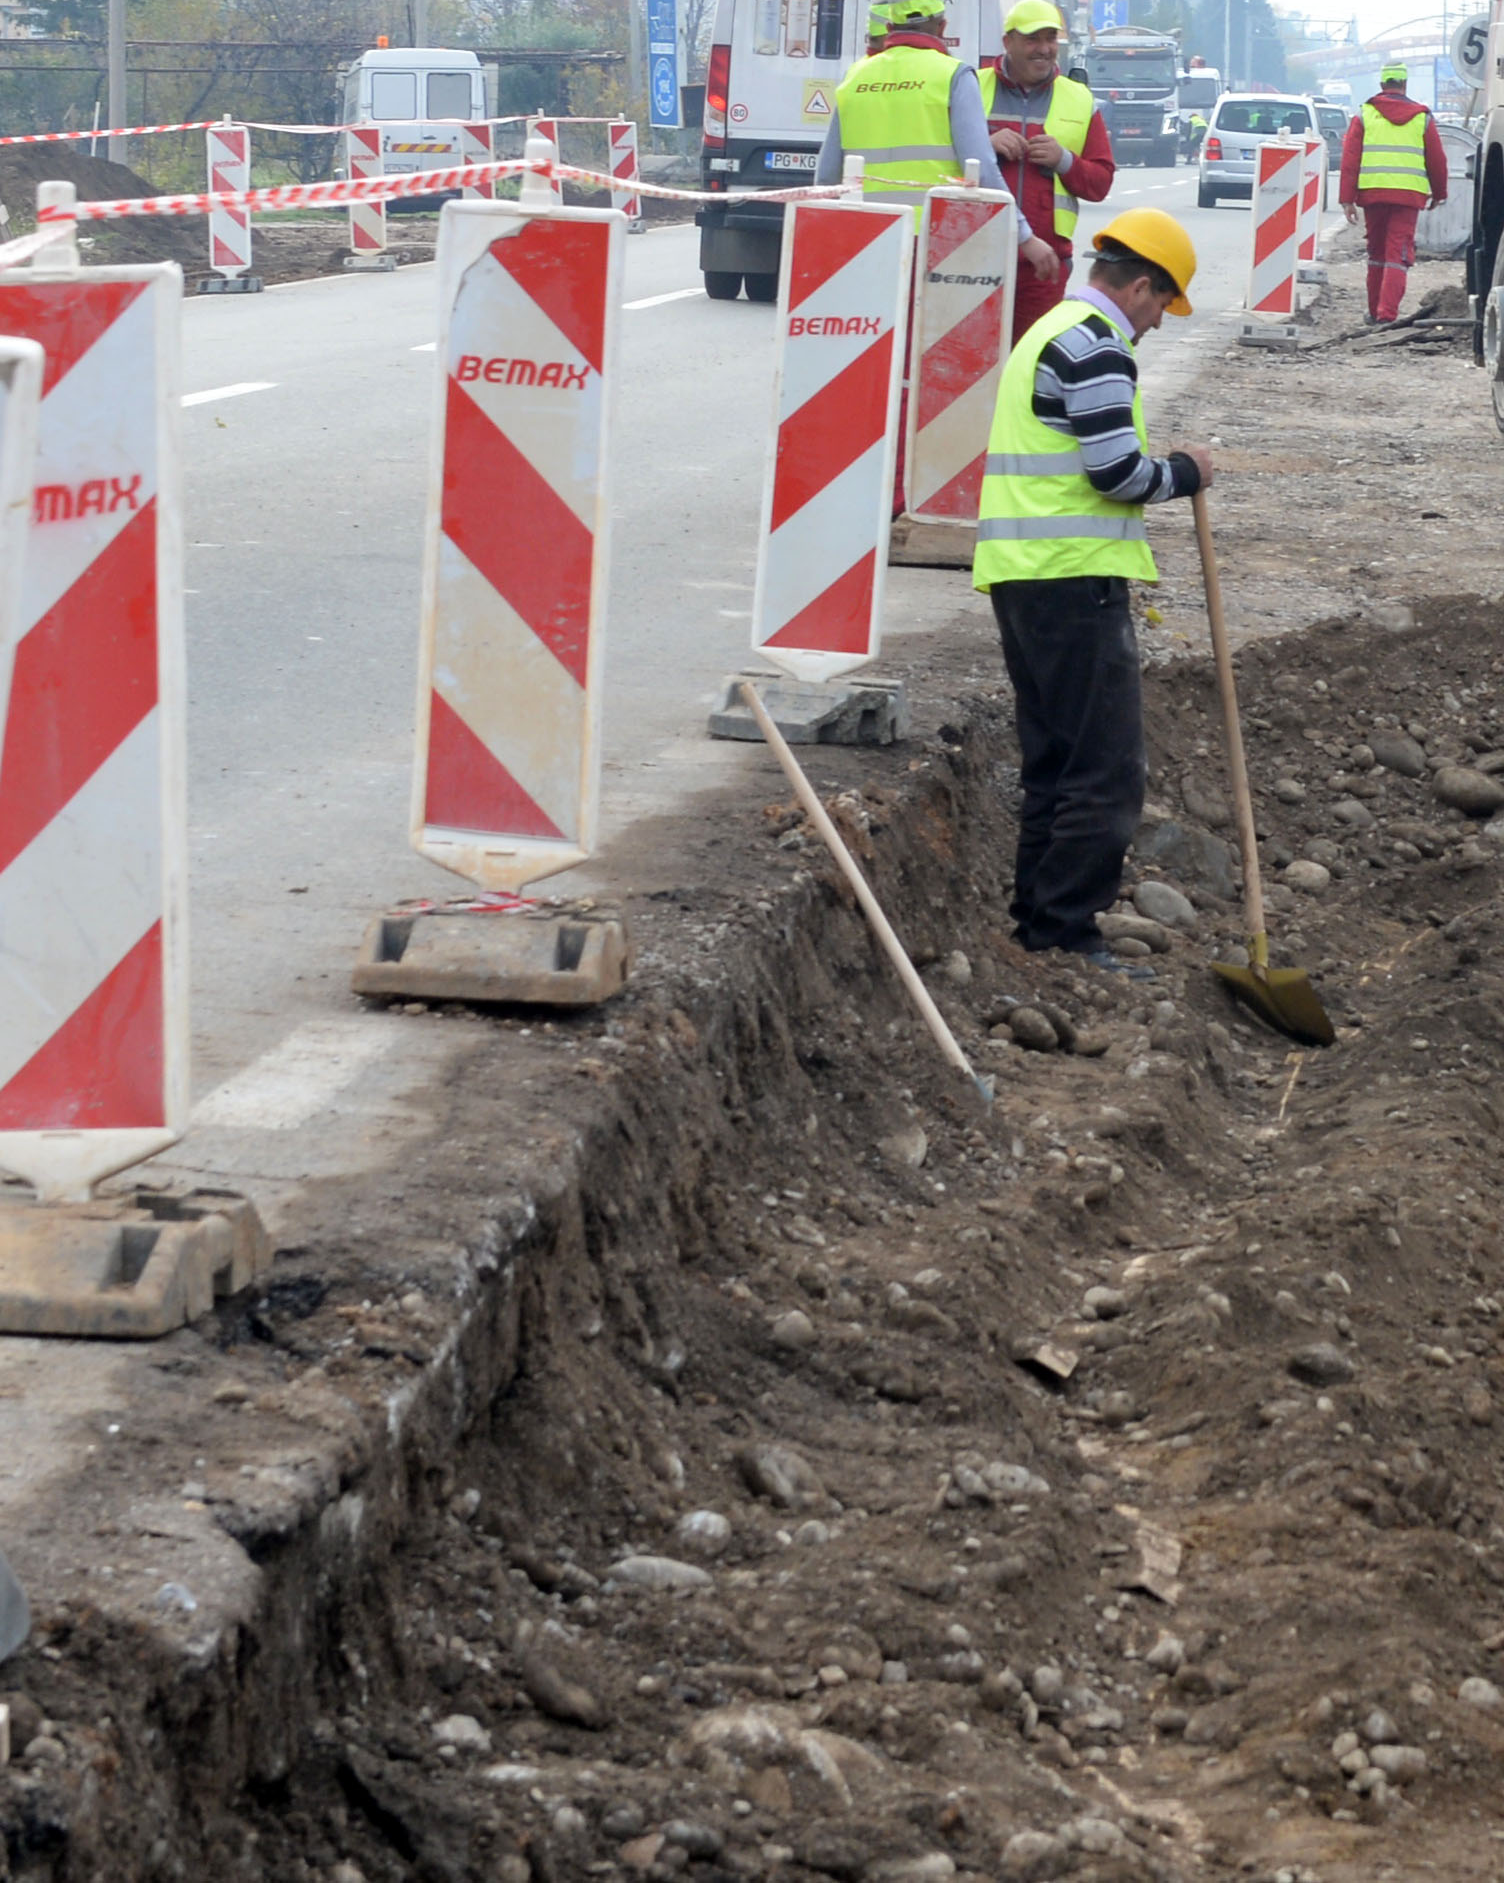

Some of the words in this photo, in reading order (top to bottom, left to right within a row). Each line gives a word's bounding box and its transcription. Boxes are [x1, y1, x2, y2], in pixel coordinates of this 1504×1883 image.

[855, 80, 927, 95] BEMAX
[774, 153, 791, 168] PG
[799, 155, 817, 169] KG
[788, 316, 881, 337] BEMAX
[456, 354, 591, 391] BEMAX
